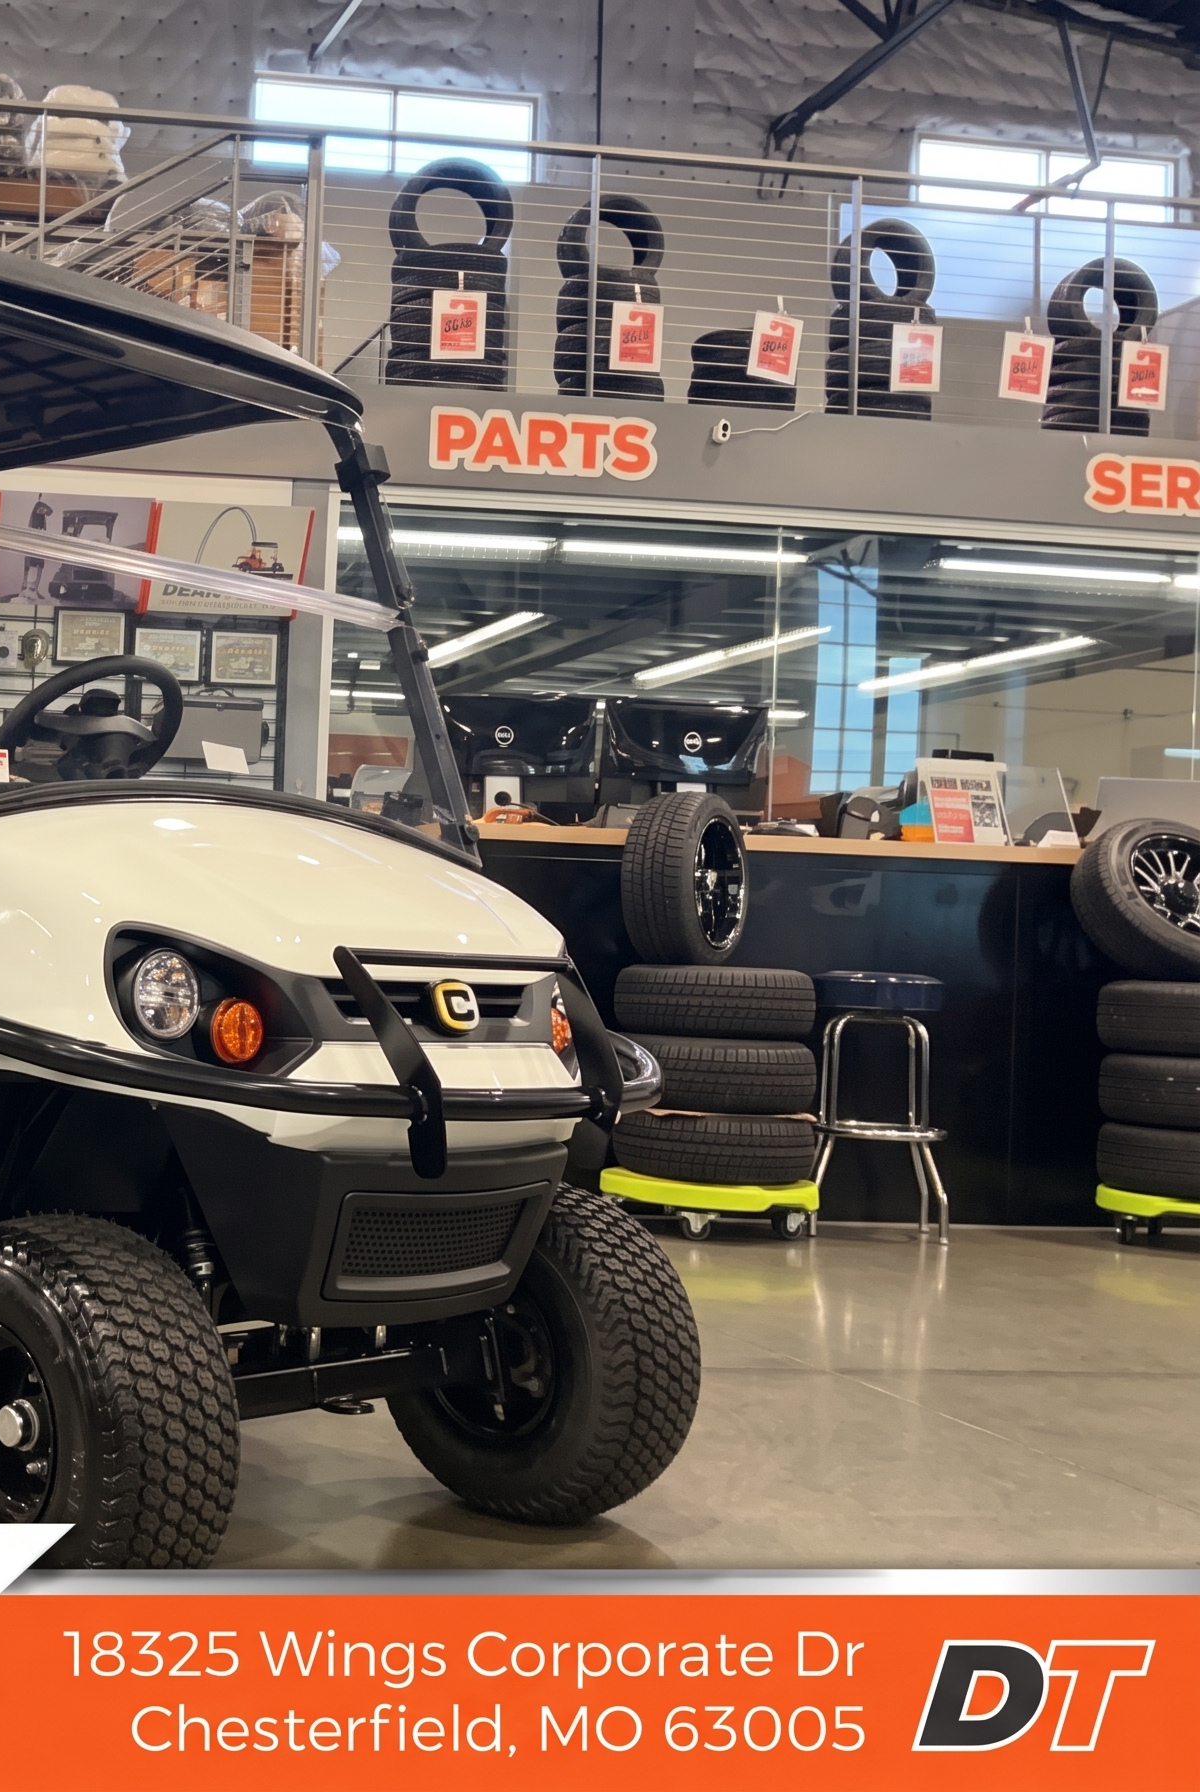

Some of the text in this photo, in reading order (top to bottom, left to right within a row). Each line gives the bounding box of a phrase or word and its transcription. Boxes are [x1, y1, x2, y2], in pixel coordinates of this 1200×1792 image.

[436, 412, 652, 474] PARTS
[1091, 459, 1200, 511] SER
[442, 989, 475, 1022] C
